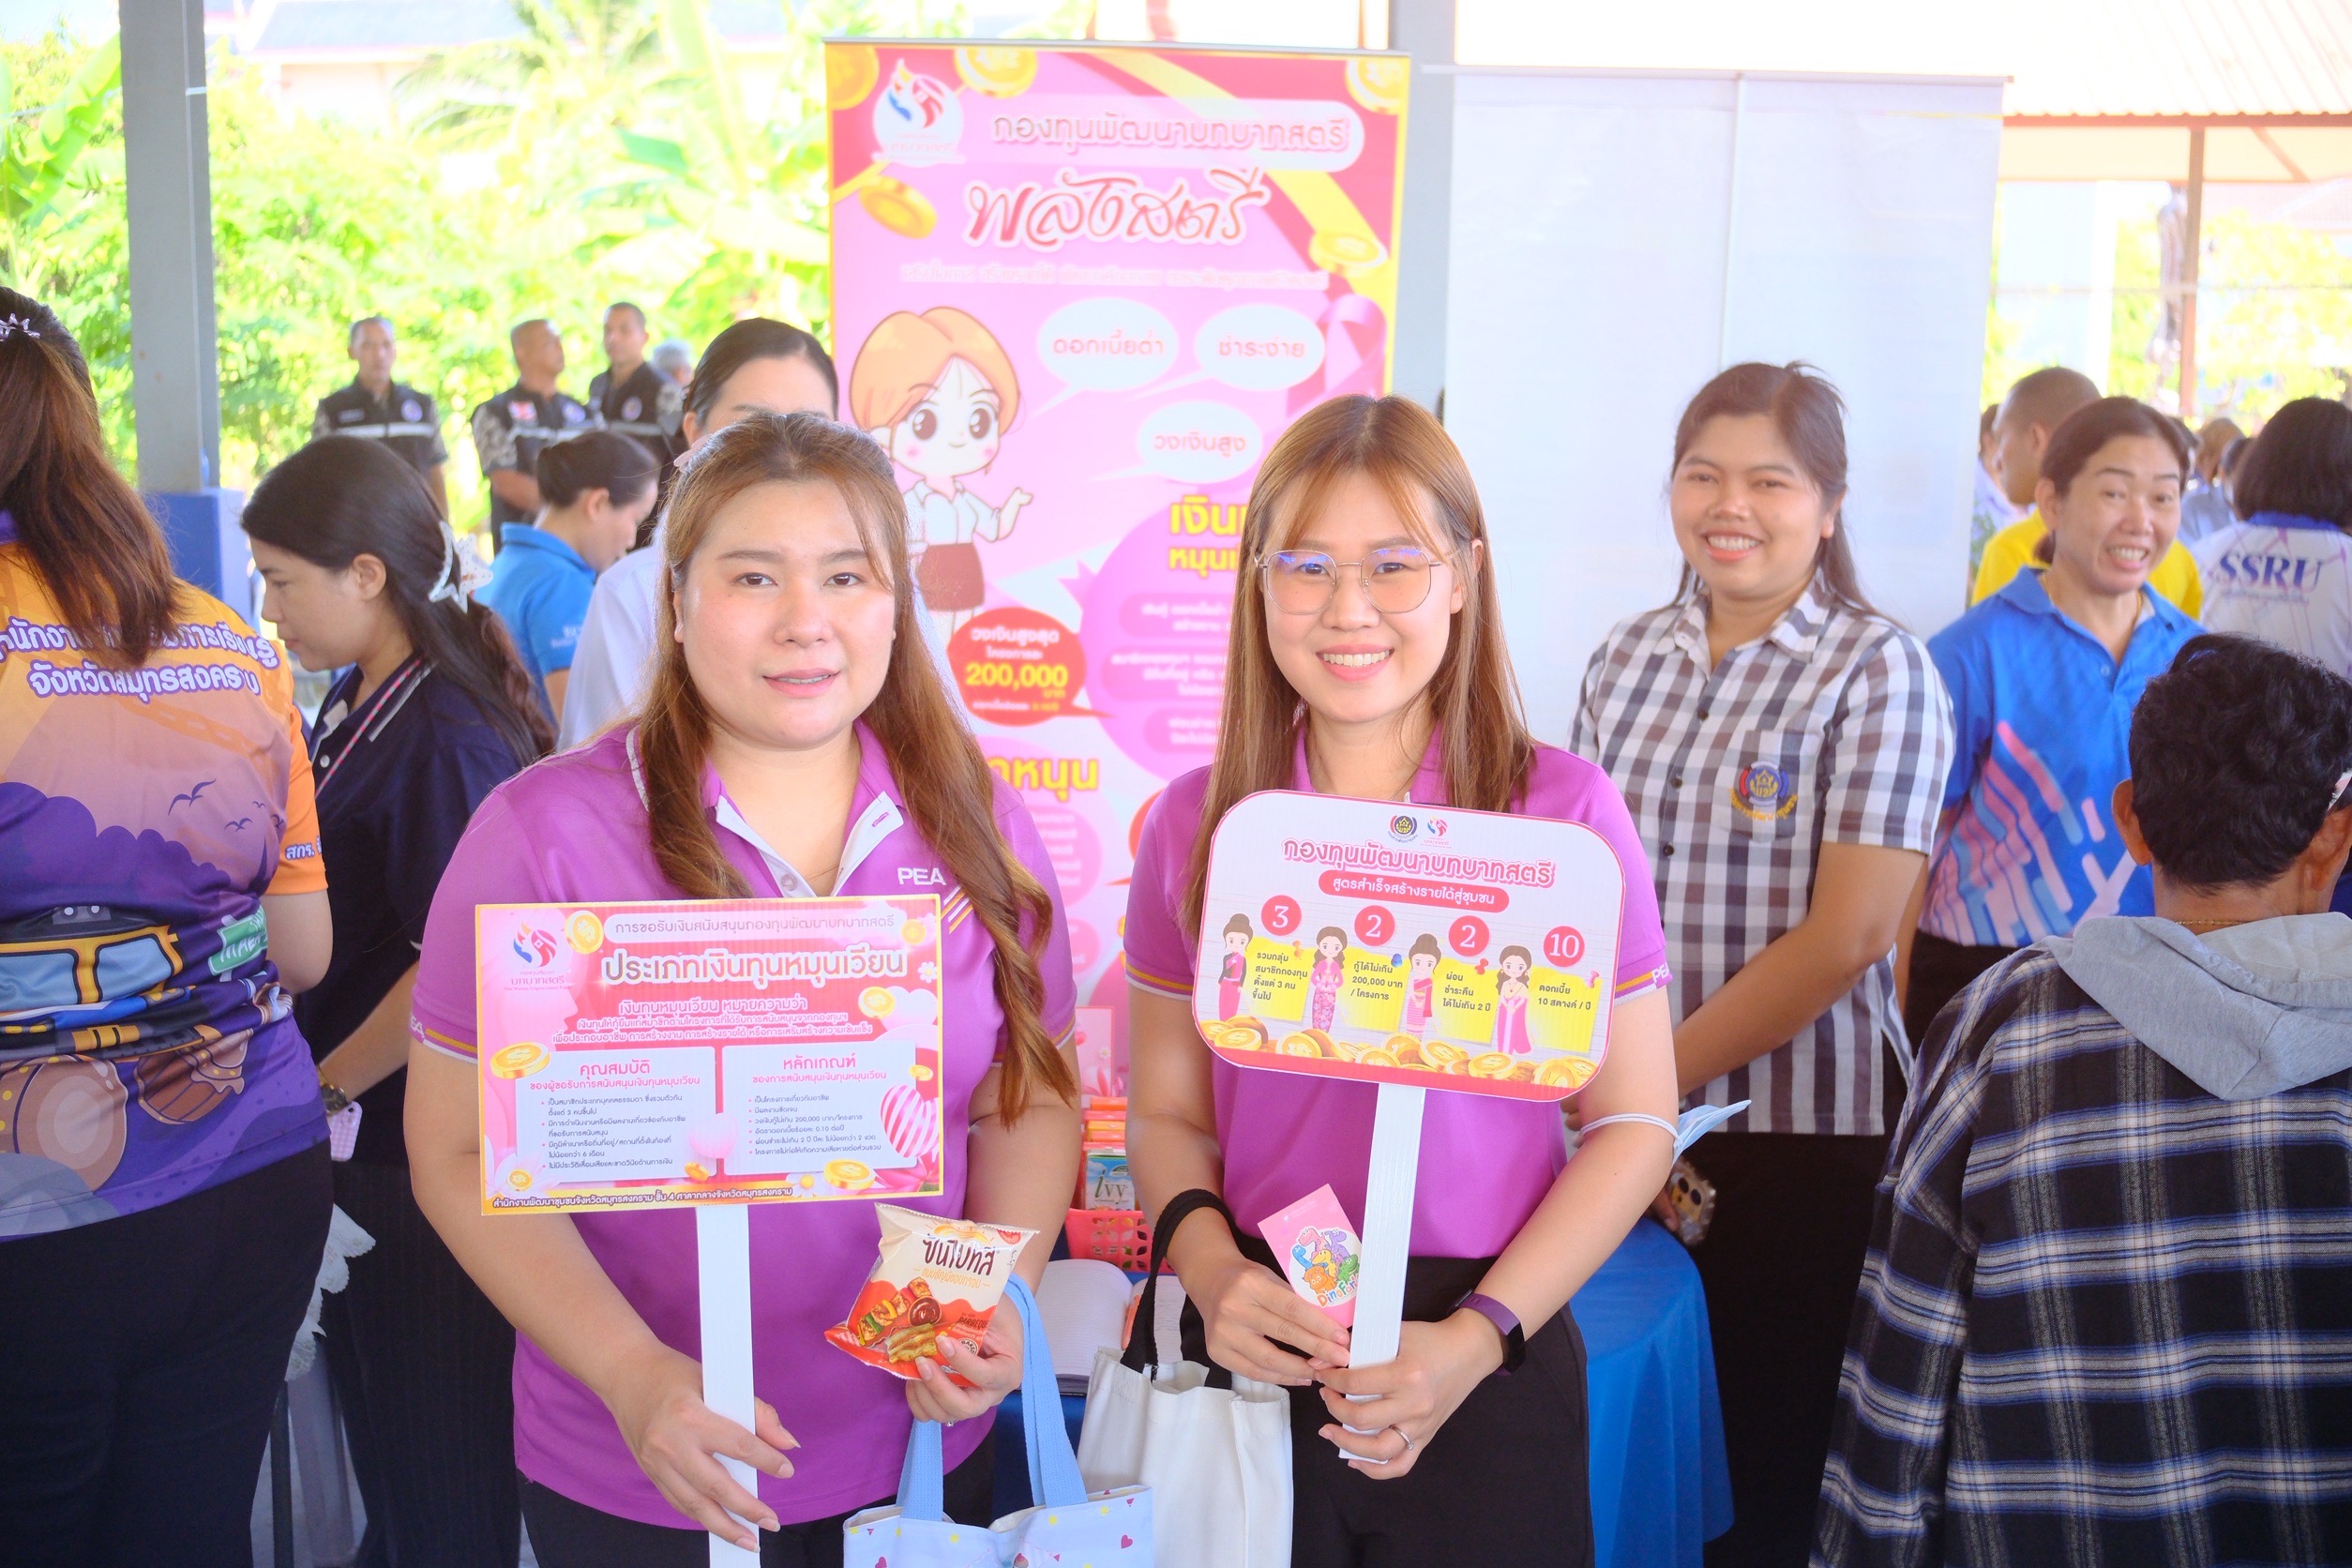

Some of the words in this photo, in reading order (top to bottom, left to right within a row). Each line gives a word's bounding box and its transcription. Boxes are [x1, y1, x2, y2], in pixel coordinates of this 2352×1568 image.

[994, 112, 1348, 151] กองทุนพัฒนาบทบาทสตรี
[968, 167, 1264, 247] พลังสตรี
[1053, 329, 1165, 357] ดอกเบี้ยต่ำ
[1218, 338, 1305, 360] ชำระง่าย
[1153, 431, 1247, 460] วงเงินสูง
[1168, 547, 1238, 579] หมุนเ
[2216, 551, 2325, 594] SSRU
[965, 662, 1069, 691] 200,000
[1282, 838, 1554, 886] กองทุนพัฒนาบทบาทสตรี
[897, 867, 946, 886] PEA
[1333, 876, 1495, 905] สูตรสำเร็จสร้างรายได้สู่ชุมชน
[615, 914, 895, 934] การขอรับเงินสนับสนุนกองทุนพัฒนาบทบาทสตรี
[1273, 906, 1289, 928] 3
[1365, 915, 1382, 937] 2
[1459, 925, 1476, 947] 2
[1549, 934, 1580, 958] 10
[604, 944, 905, 987] ประเภทเงินทุนหมุนเวียน
[1257, 951, 1289, 963] รวมกลุ่ม
[1353, 961, 1394, 974] กู้ได้ไม่เกิน
[511, 975, 565, 986] บทบาทสตรี
[1253, 975, 1276, 988] ตั้งแต่
[1255, 965, 1308, 980] สมาชิกกองทุน
[1351, 976, 1385, 987] 200,000
[1387, 980, 1403, 988] บาท
[1446, 971, 1464, 982] ผ่อน
[1252, 987, 1272, 1001] ขึ้นไป
[1356, 988, 1390, 1001] โครงการ
[1444, 986, 1474, 997] ชำระคืน
[1539, 983, 1571, 995] ดอกเบี้ย
[619, 997, 718, 1017] เงินทุนหมุนเวียน
[723, 994, 807, 1012] หมายความว่า
[1442, 998, 1476, 1010] ได้ไม่เกิน
[1485, 1003, 1491, 1012] ปี
[1549, 999, 1577, 1009] สตางค์
[1585, 1001, 1591, 1011] ปี
[553, 1030, 626, 1043] เพื่อประกอบอาชีพ
[629, 1027, 683, 1040] การสร้างงาน
[685, 1025, 746, 1039] การสร้างรายได้
[748, 1021, 873, 1036] หรือการเสริมสร้างความเข้มแข็ง
[580, 1060, 651, 1080] คุณสมบัติ
[783, 1053, 857, 1070] หลักเกณฑ์
[530, 1075, 701, 1092] ของผู้ขอรับการสนับสนุนเงินทุนหมุนเวียน
[752, 1071, 887, 1084] ของการสนับสนุนเงินทุนหมุนเวียน
[1094, 1168, 1126, 1205] ivy
[493, 1194, 654, 1209] สำนักงานพัฒนาชุมชนจังหวัดสมุทรสงคราม
[656, 1189, 668, 1201] ชั้น
[668, 1192, 675, 1201] 4
[676, 1186, 793, 1201] ศาลากลางจังหวัดสมุทรสงคราม
